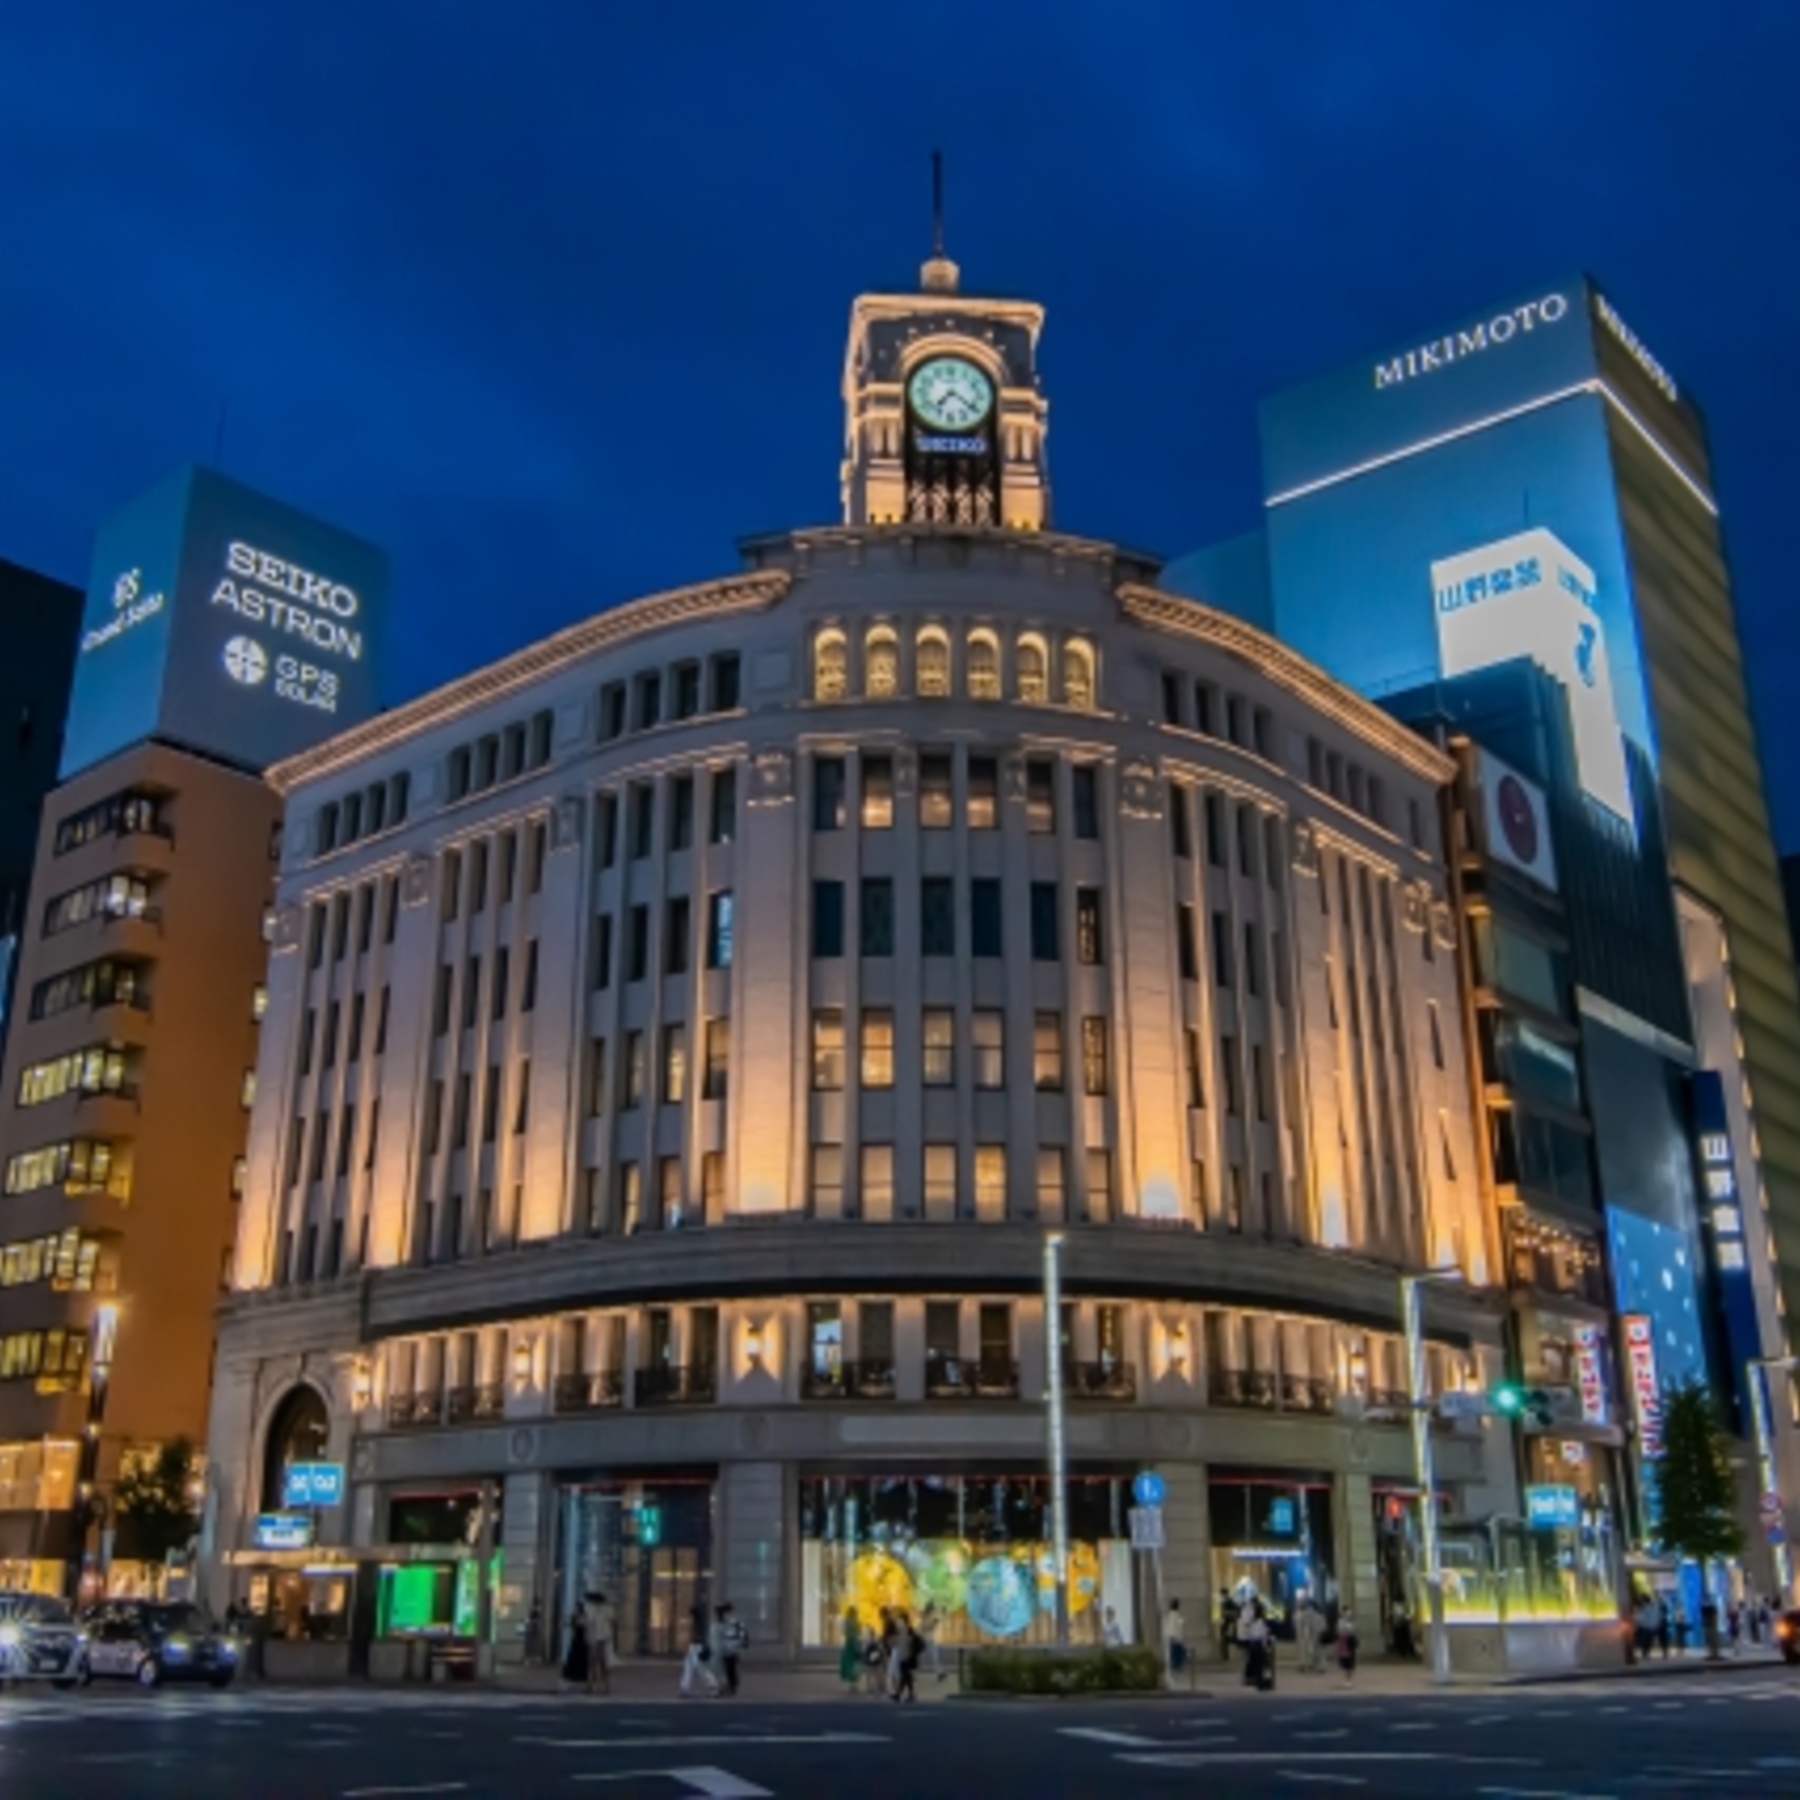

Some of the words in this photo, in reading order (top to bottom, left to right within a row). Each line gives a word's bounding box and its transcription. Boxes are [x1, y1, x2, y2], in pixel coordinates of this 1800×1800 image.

[1374, 294, 1567, 389] MIKIMOTO
[227, 541, 358, 617] SEIKO
[211, 578, 361, 659] ASTRON
[276, 655, 338, 697] GPS
